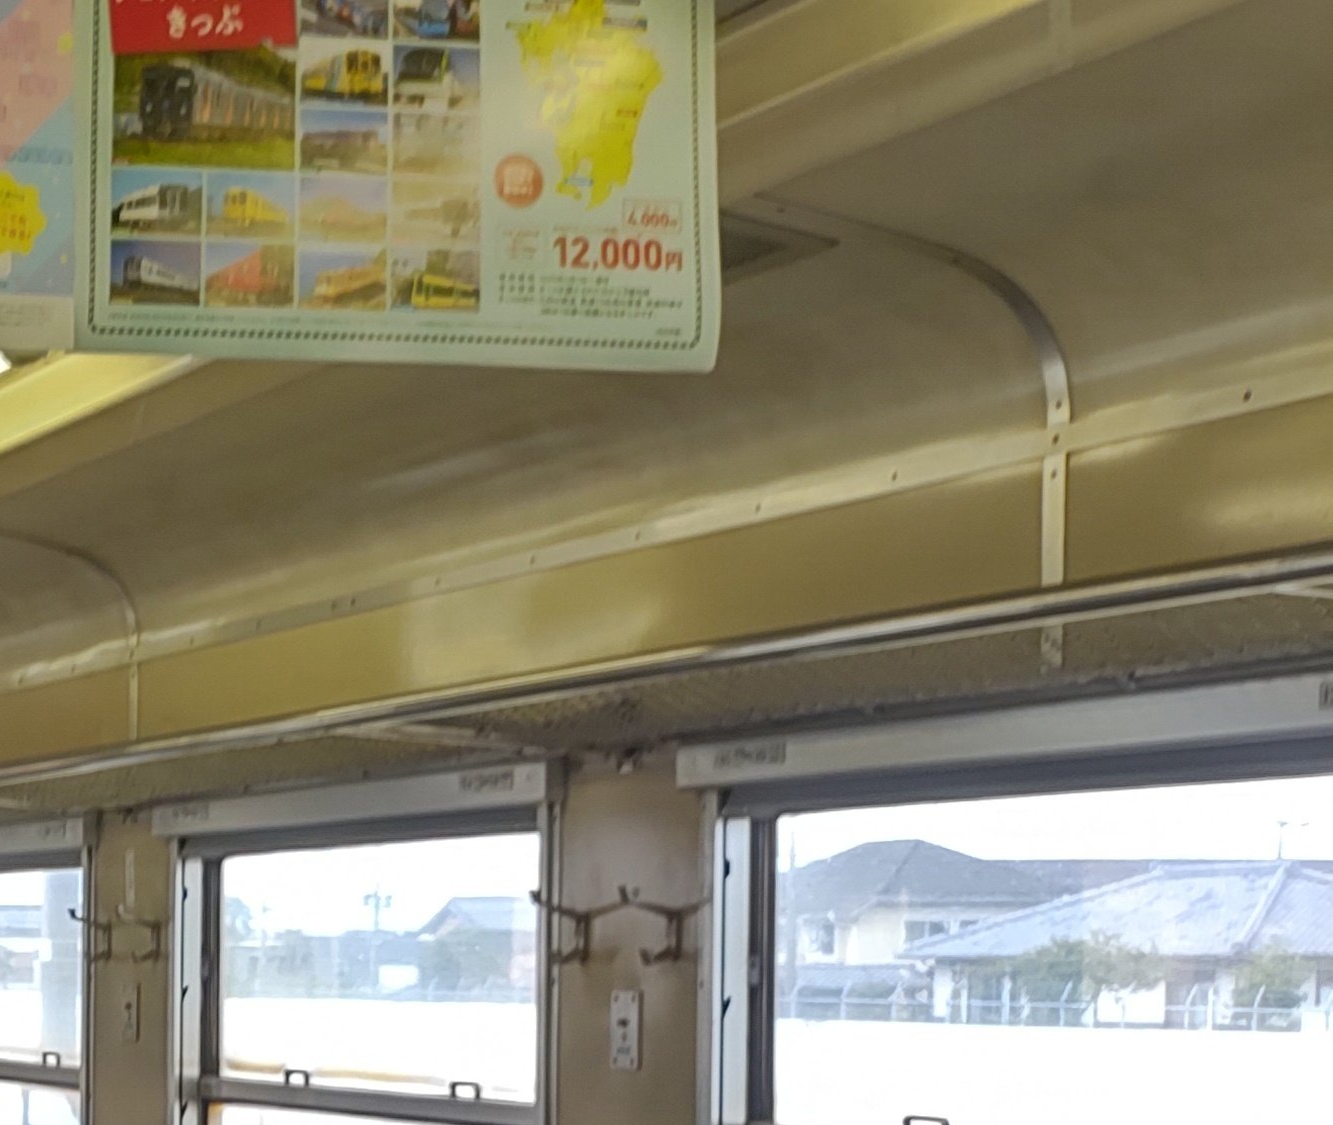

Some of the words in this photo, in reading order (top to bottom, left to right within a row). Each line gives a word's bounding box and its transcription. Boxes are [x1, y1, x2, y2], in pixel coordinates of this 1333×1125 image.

[166, 4, 244, 39] きっぷ
[553, 234, 683, 272] 12,000円
